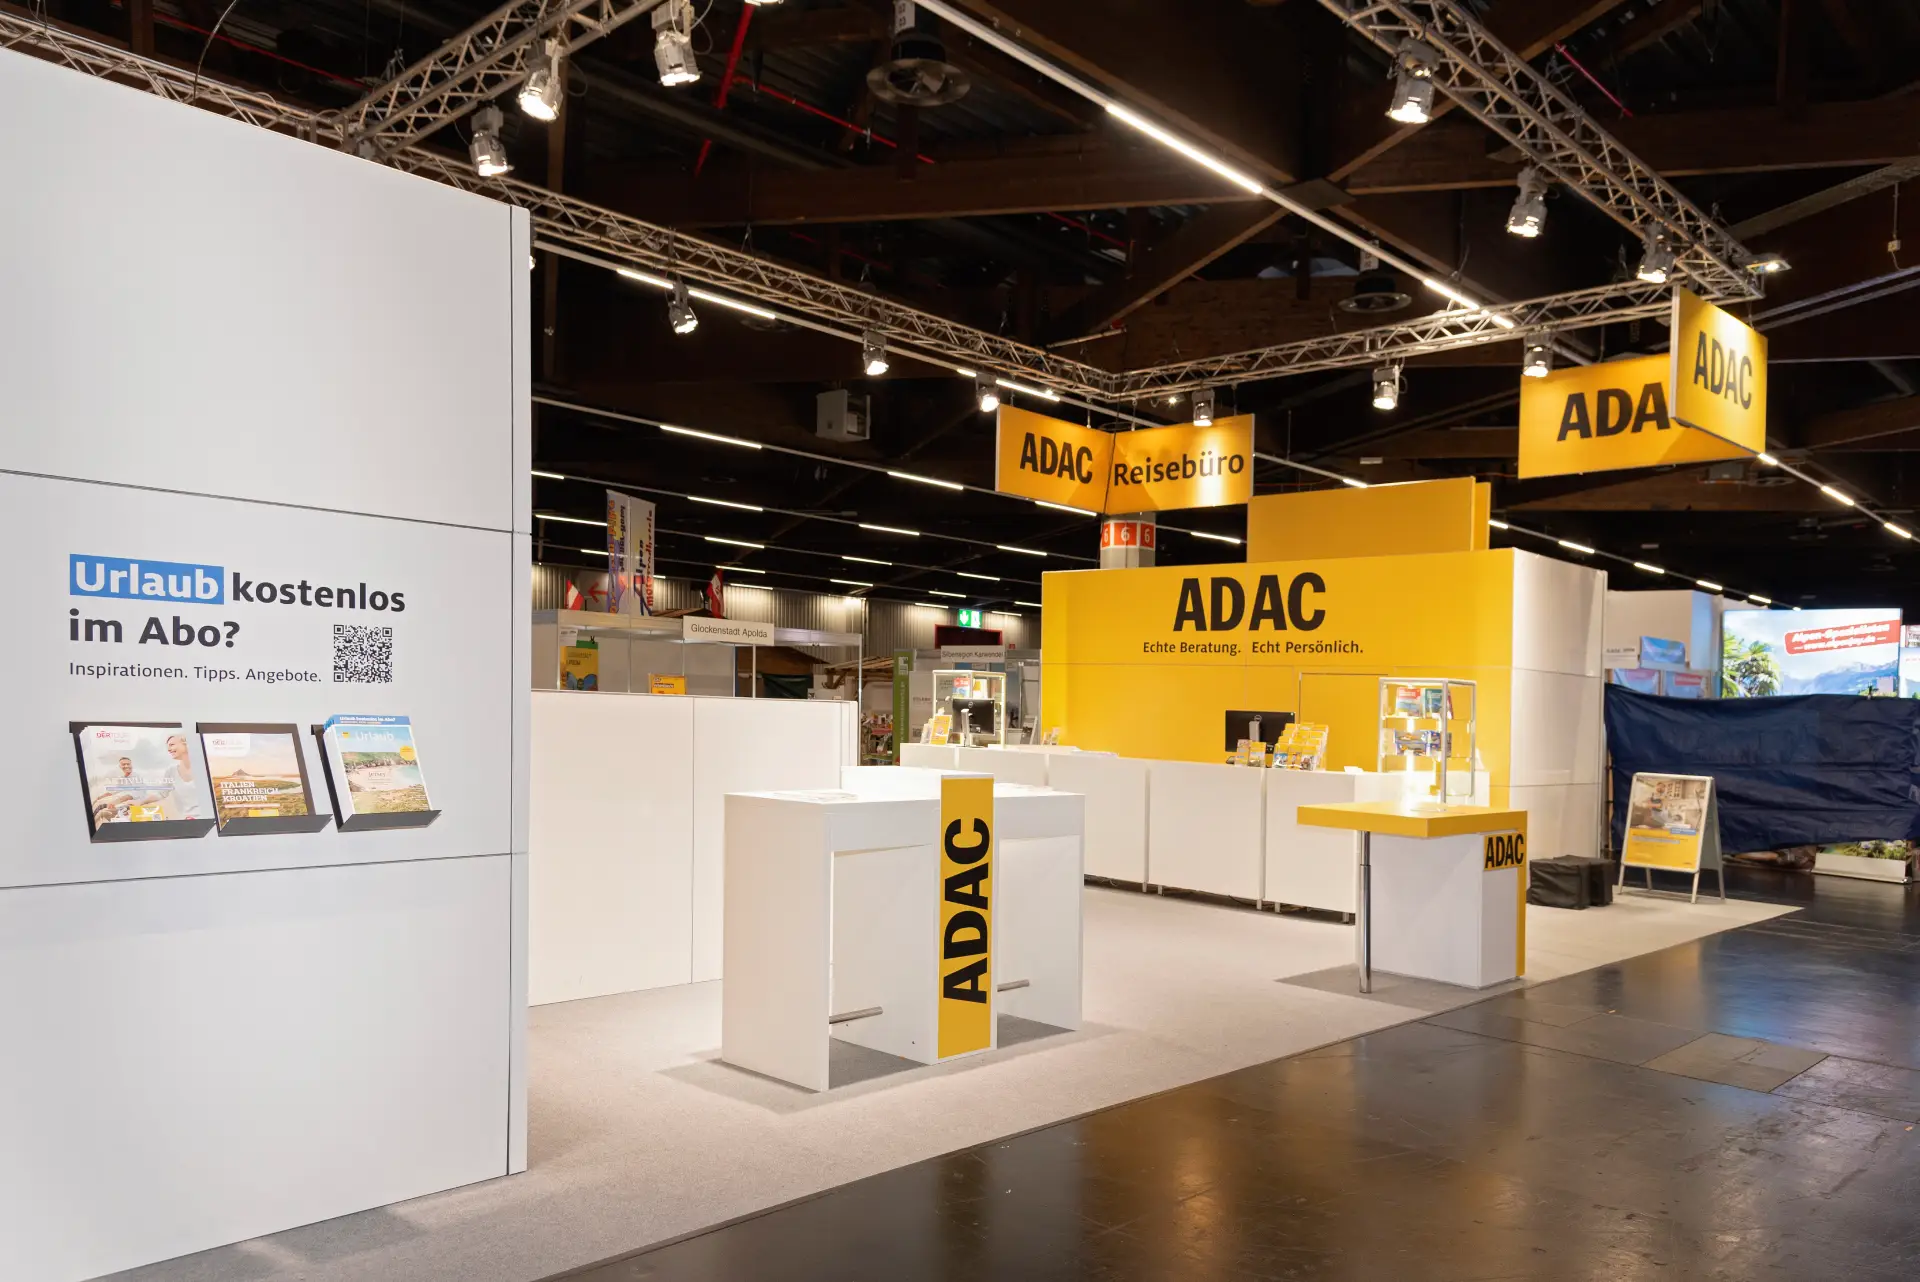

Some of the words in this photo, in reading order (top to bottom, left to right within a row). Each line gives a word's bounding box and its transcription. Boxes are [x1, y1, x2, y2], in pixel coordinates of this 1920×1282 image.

[1693, 329, 1753, 410] ADAC
[1556, 381, 1692, 442] ADA
[1019, 432, 1094, 485] ADAC
[1113, 450, 1245, 487] Reisebüro
[1104, 528, 1109, 543] 6
[1121, 526, 1130, 543] 6
[1144, 528, 1151, 543] 6
[76, 561, 219, 600] Urlaub
[232, 571, 406, 613] kostenlos
[1172, 571, 1326, 632] ADAC
[70, 608, 123, 643] im
[138, 615, 241, 648] Abo?
[691, 623, 740, 636] Glockenstadt
[742, 628, 768, 639] Apolda
[1143, 641, 1176, 653] Echte
[1180, 641, 1241, 656] Beratung.
[1252, 640, 1281, 653] Echt
[1285, 640, 1363, 653] Persönlich.
[69, 662, 188, 679] Inspirationen.
[194, 666, 240, 682] Tipps.
[246, 668, 322, 684] Angebote.
[356, 731, 394, 741] Urlaub
[1484, 833, 1524, 869] ADAC
[942, 817, 990, 1004] ADAC
